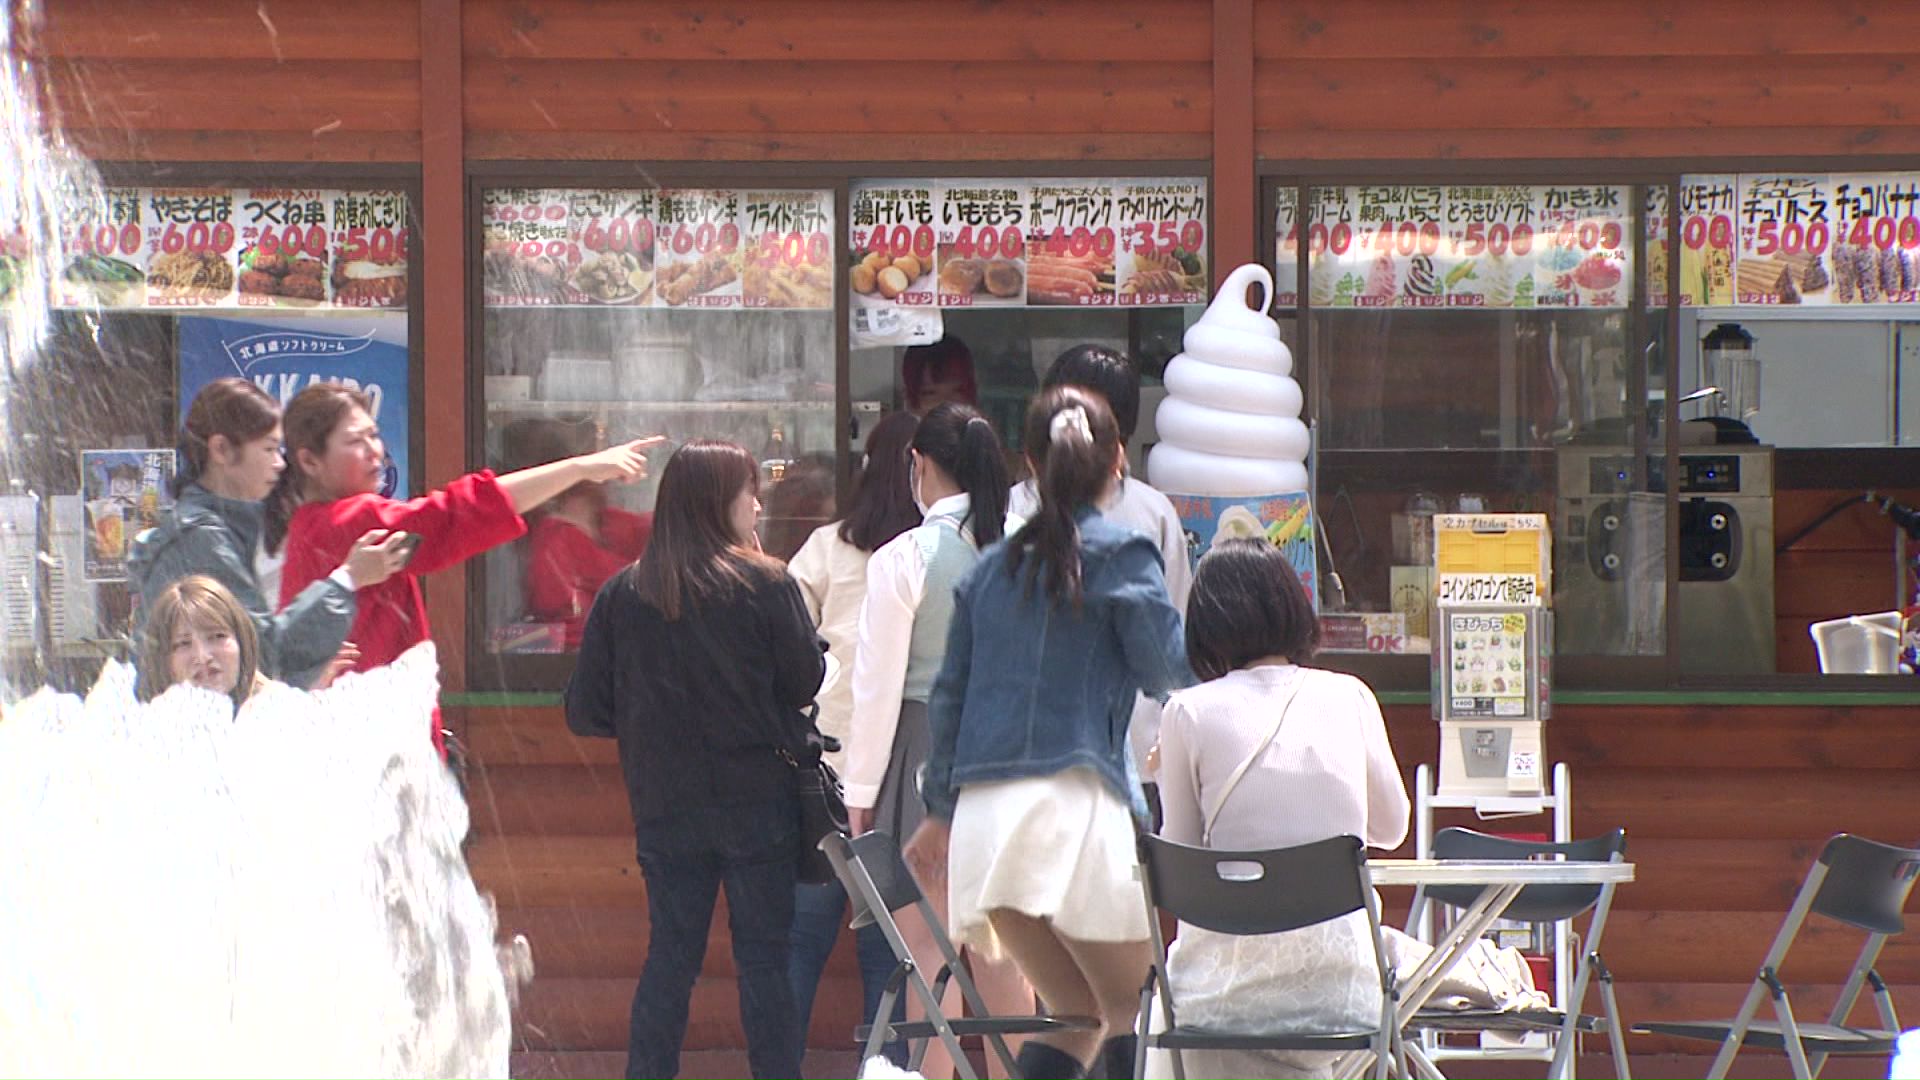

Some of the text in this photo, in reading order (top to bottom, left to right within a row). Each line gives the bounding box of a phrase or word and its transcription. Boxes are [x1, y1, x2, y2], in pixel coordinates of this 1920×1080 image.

[856, 189, 929, 200] 北海道名物
[945, 189, 1018, 201] 北海道名物
[1358, 187, 1441, 204] チョコ&バニラ
[1545, 187, 1618, 208] かき氷
[1836, 184, 1919, 220] チョコバナナ
[151, 196, 232, 222] やきそば
[243, 201, 325, 224] つくね串
[746, 202, 828, 233] フライドポテト
[853, 201, 933, 226] 揚げいも
[943, 202, 1023, 225] いももち
[1447, 203, 1535, 223] とうきびソフト
[239, 339, 345, 360] 北海道ソフトクリーム
[1367, 634, 1404, 652] OK
